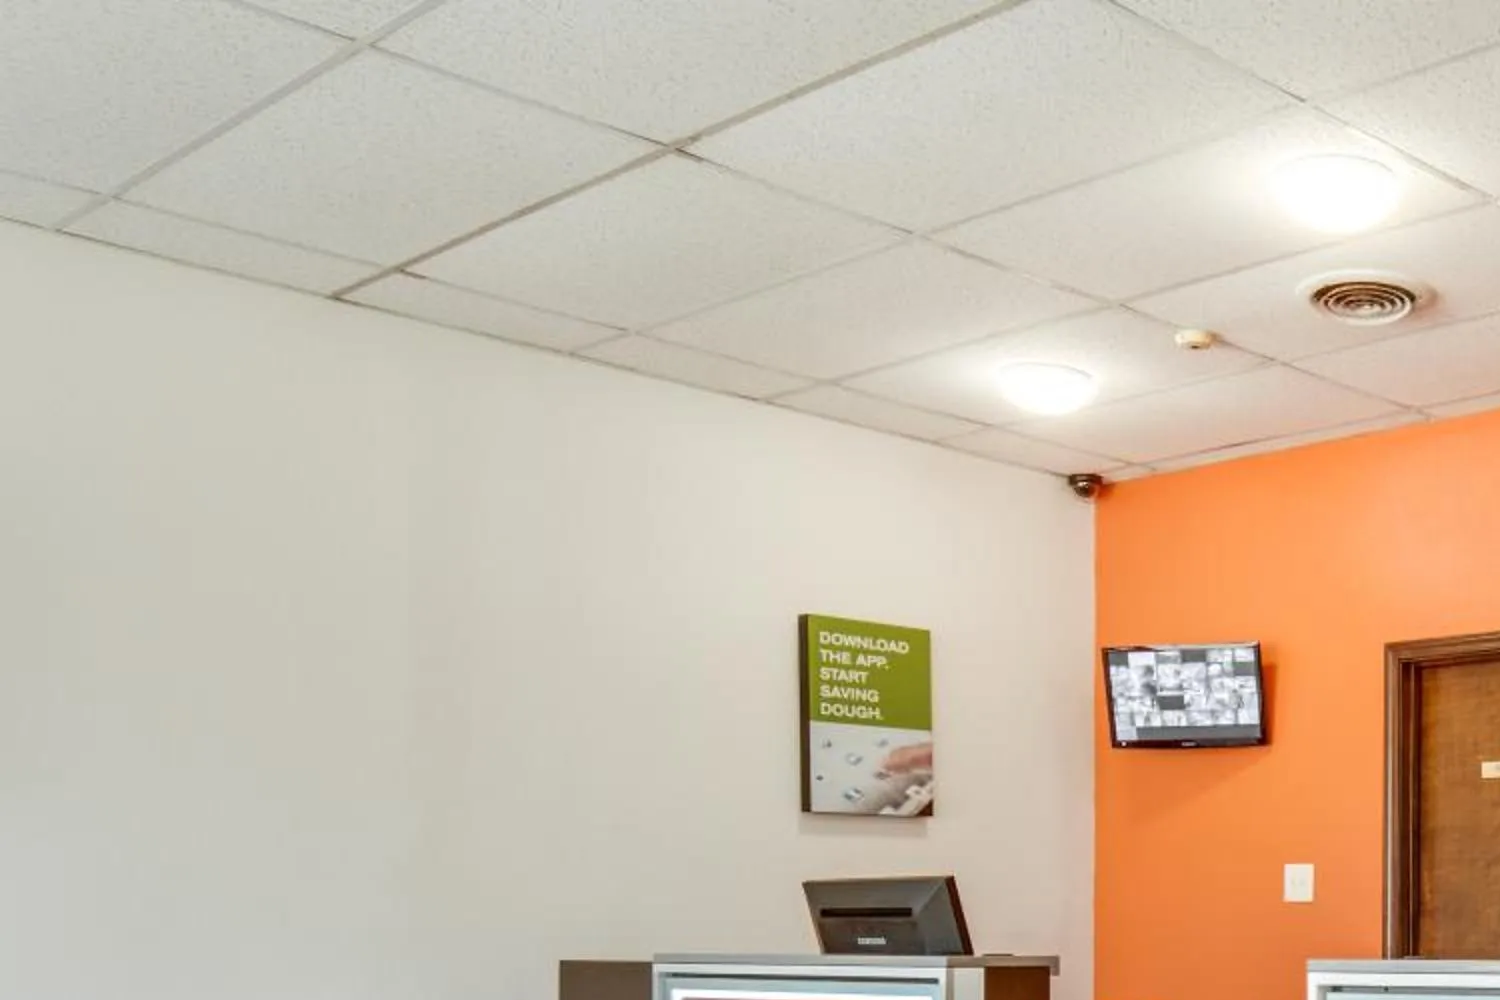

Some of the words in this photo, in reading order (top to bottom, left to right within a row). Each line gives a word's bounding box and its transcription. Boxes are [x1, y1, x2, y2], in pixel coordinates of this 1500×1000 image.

[820, 631, 909, 653] DOWNLOAD
[819, 649, 850, 664] THE
[856, 655, 889, 669] APP.
[820, 667, 868, 683] START
[819, 685, 880, 703] SAVING
[821, 703, 883, 720] DOUGH.
